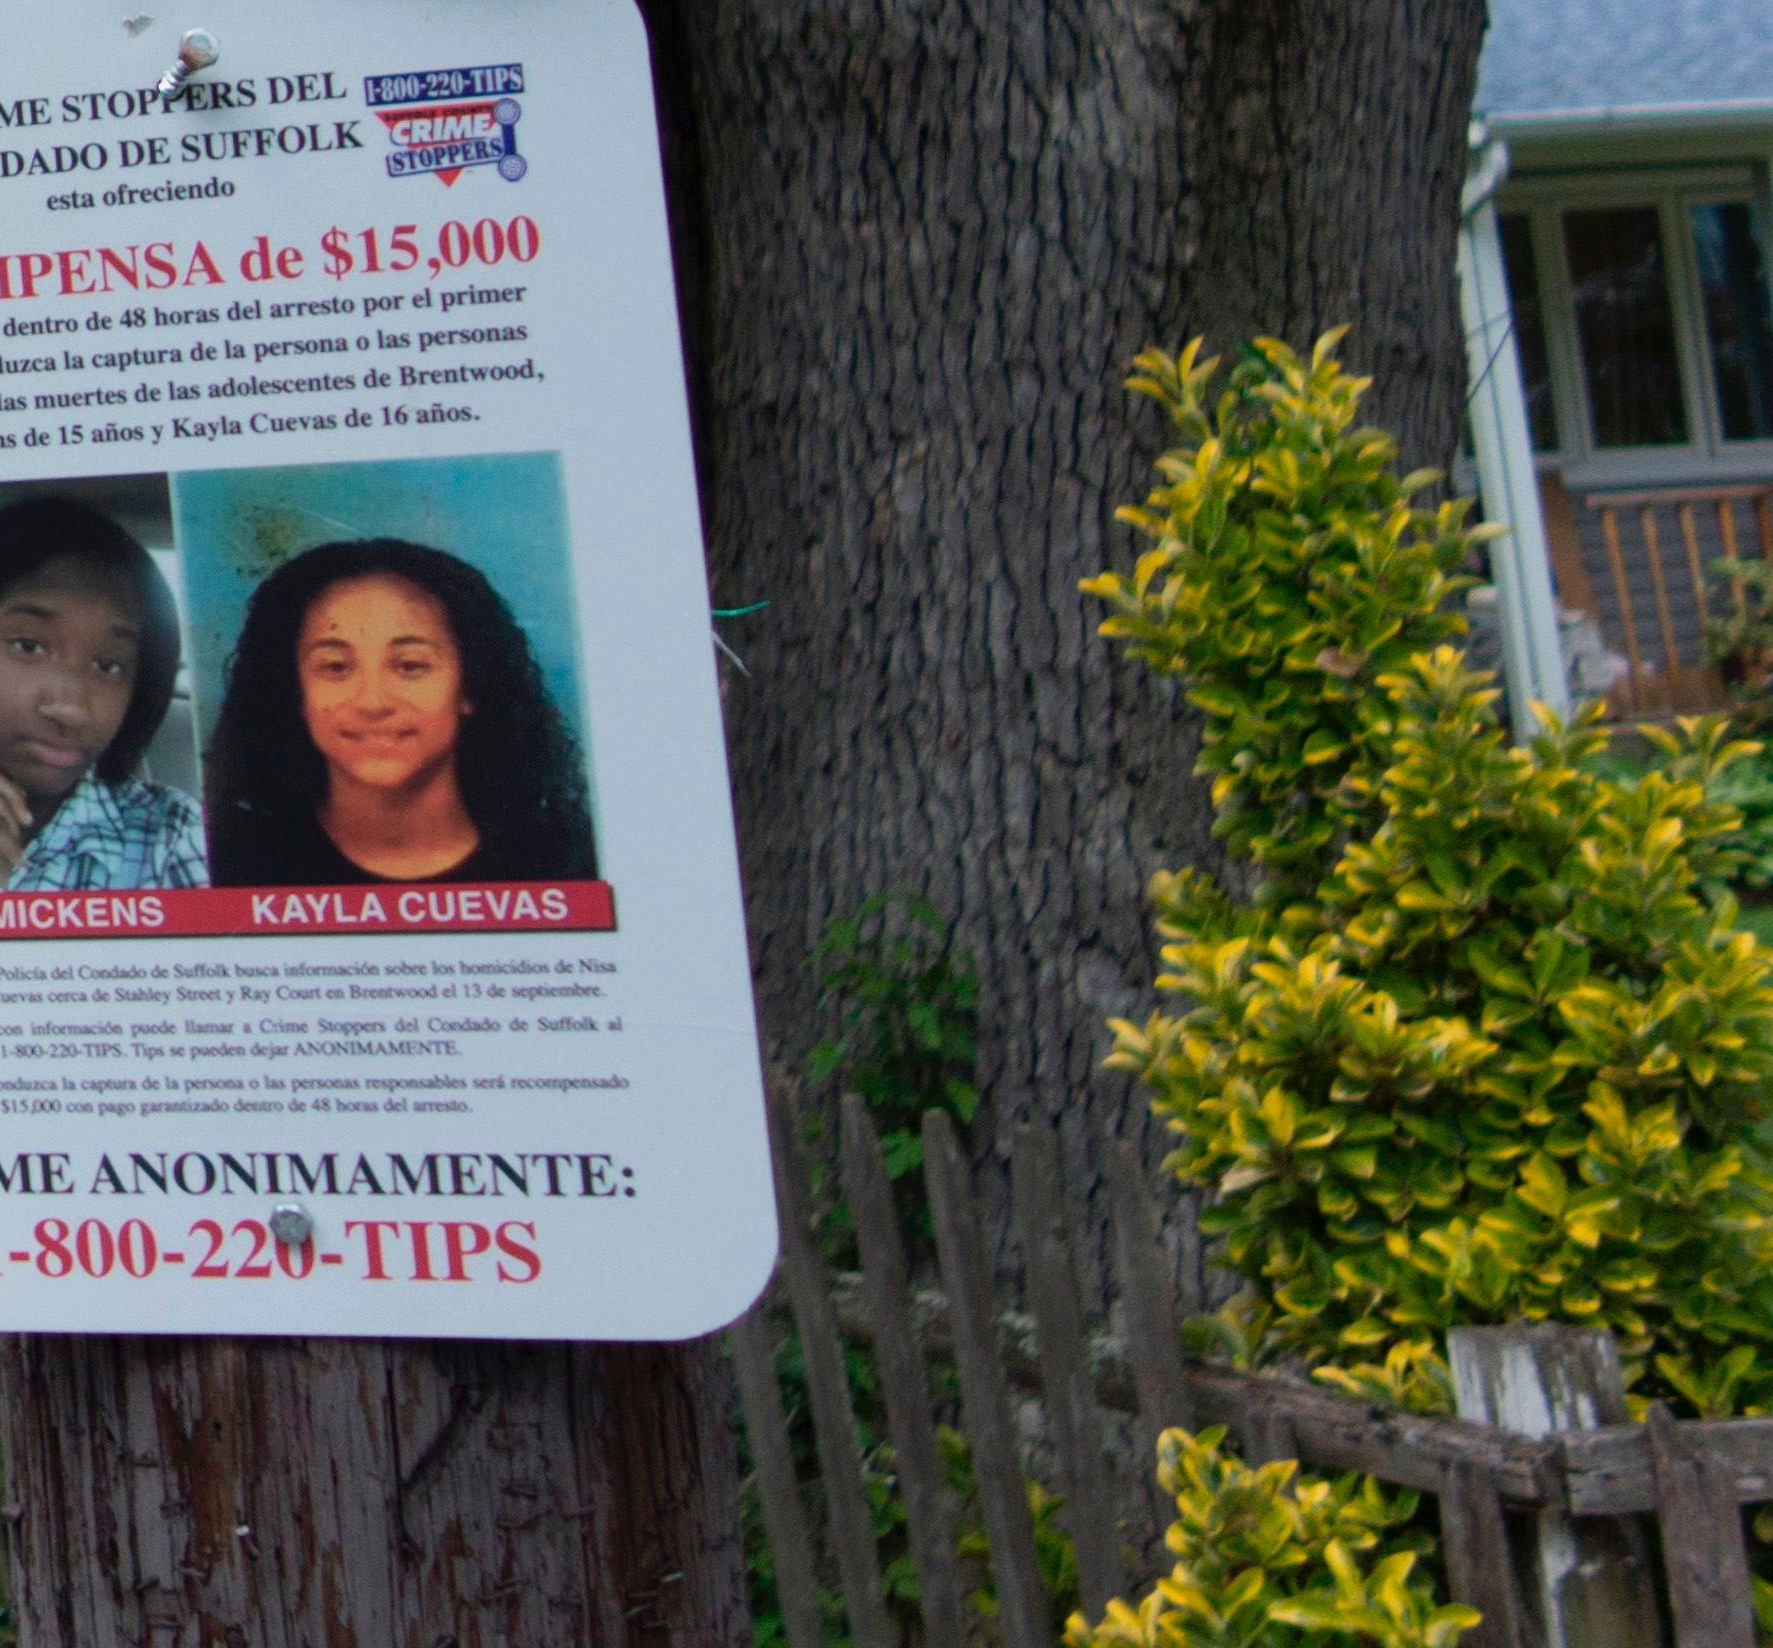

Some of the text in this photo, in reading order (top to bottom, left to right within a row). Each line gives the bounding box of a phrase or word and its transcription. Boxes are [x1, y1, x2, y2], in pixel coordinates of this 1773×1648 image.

[267, 72, 347, 104] DEL
[367, 65, 522, 102] 1-800-220-TIPS
[119, 137, 171, 167] DE
[181, 120, 363, 162] SUFFOLK
[391, 113, 493, 145] CRIME
[393, 137, 504, 172] STOPPERS
[46, 176, 235, 211] esta ofreciendo
[239, 236, 303, 282] de
[320, 215, 539, 281] $15,000
[3, 316, 79, 337] dentro
[85, 311, 112, 331] de
[119, 308, 147, 328] 48
[153, 306, 220, 326] horas
[227, 299, 262, 321] del
[270, 296, 355, 318] arresto
[363, 295, 405, 317] por
[411, 287, 432, 309] el
[440, 284, 527, 312] primer
[63, 350, 85, 370] la
[91, 348, 183, 372] captura
[190, 341, 217, 362] de
[224, 339, 246, 359] la
[253, 337, 349, 363] persona
[355, 335, 370, 351] o
[377, 329, 411, 349] las
[418, 325, 528, 352] personas
[34, 388, 127, 409] muertes
[134, 382, 161, 403] de
[168, 381, 201, 400] las
[208, 374, 356, 398] adolescentes
[363, 368, 391, 389] de
[399, 358, 544, 386] Brentwood,
[23, 427, 50, 447] de
[59, 424, 84, 445] 15
[91, 422, 144, 443] años
[151, 425, 163, 445] y
[172, 415, 242, 441] Kayla
[249, 413, 337, 434] Cuevas
[344, 407, 372, 428] de
[381, 406, 409, 426] 16
[415, 403, 480, 424] años.
[251, 888, 568, 924] KAYLA CUEVAS
[130, 1042, 165, 1061] Tips
[169, 1046, 185, 1057] se
[190, 1042, 246, 1060] pueden
[249, 1042, 289, 1060] dejar
[90, 1153, 635, 1198] ANONIMAMENTE:
